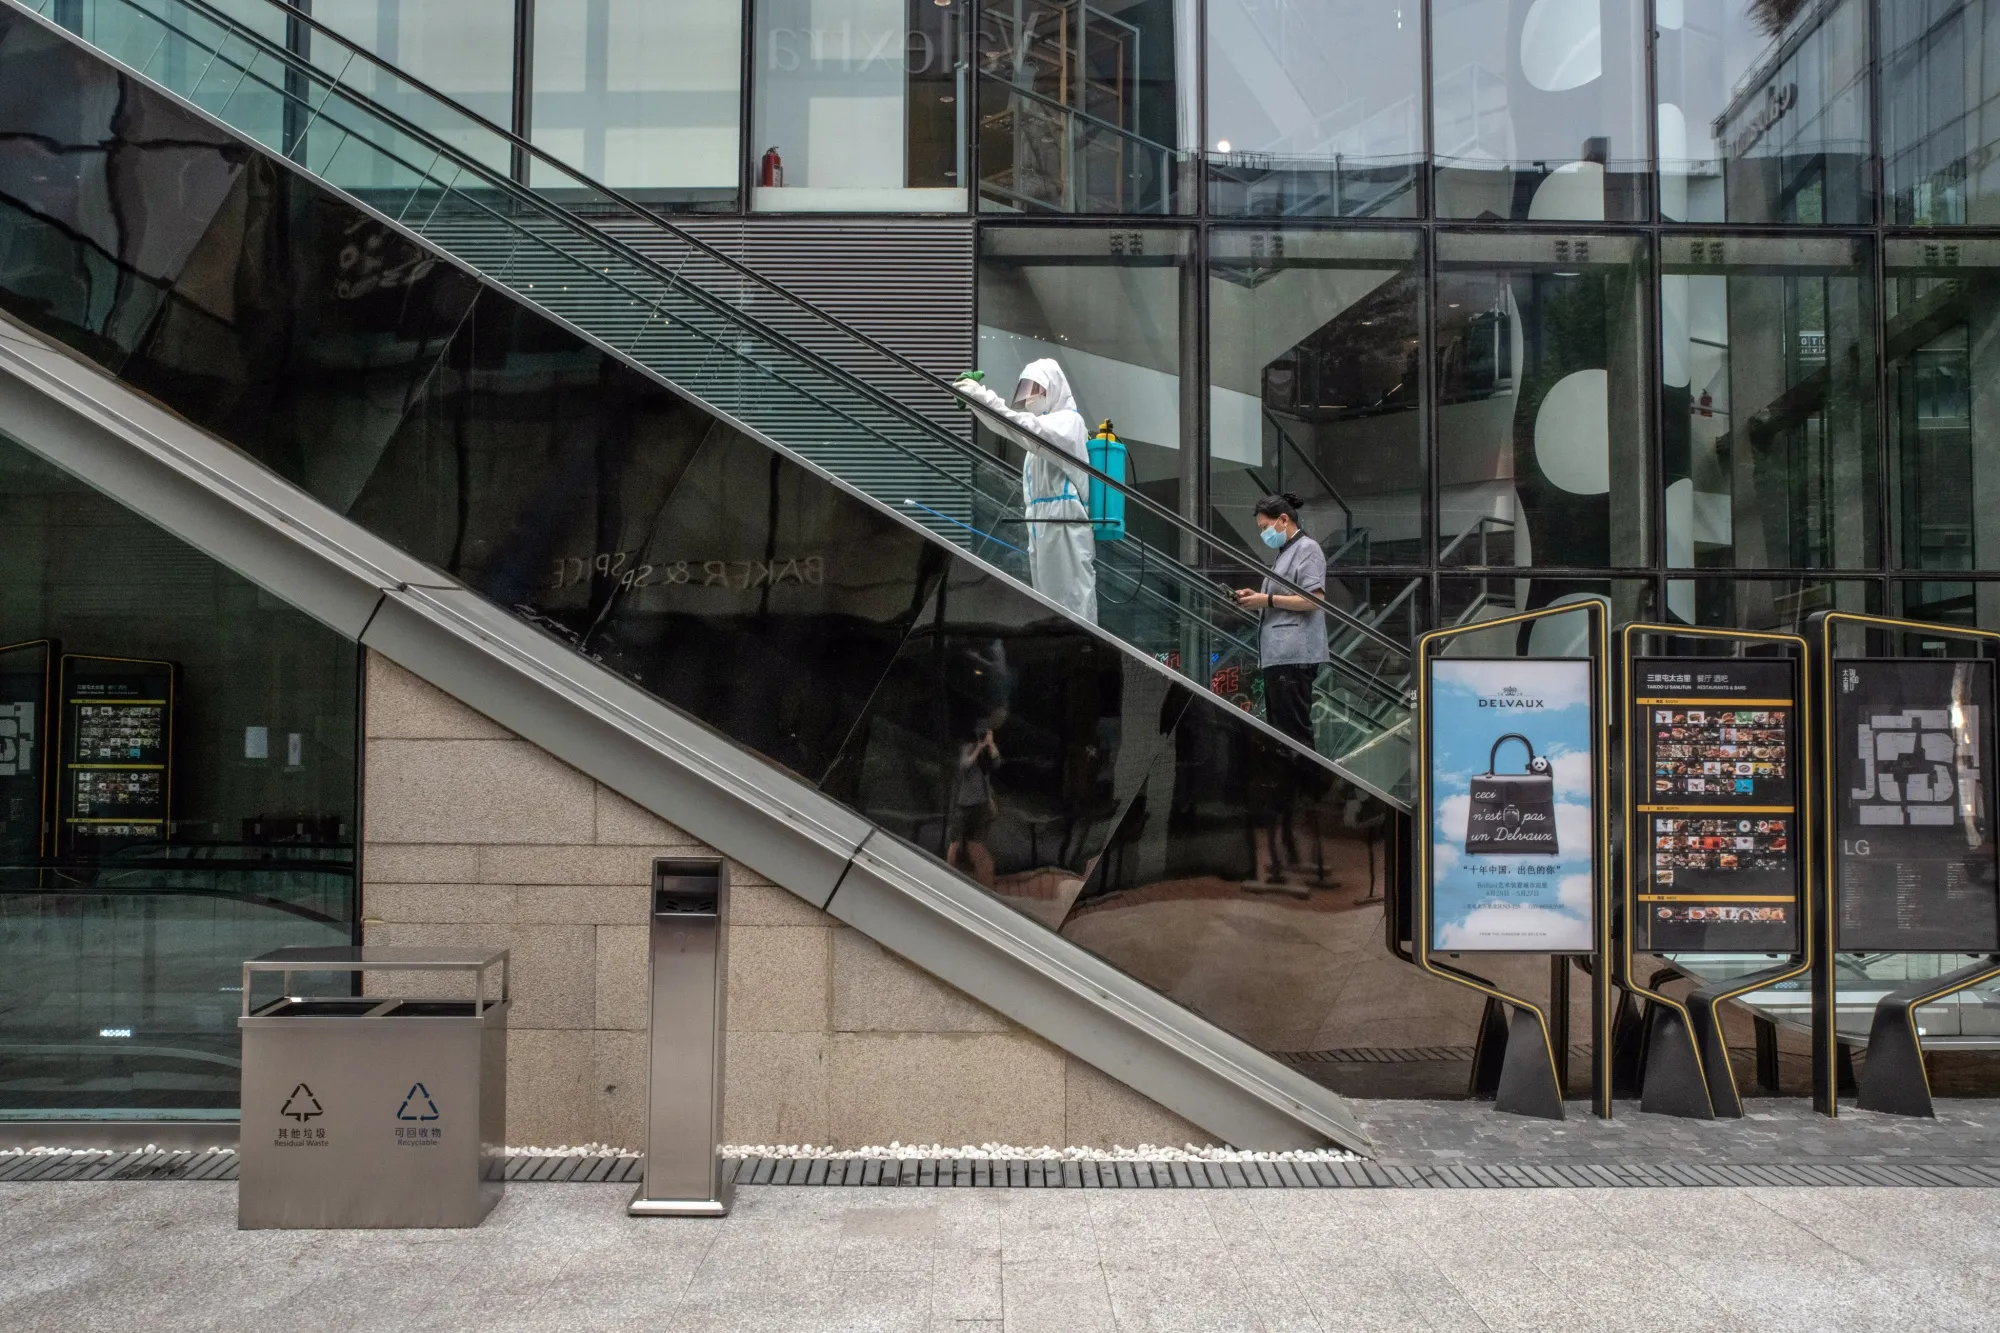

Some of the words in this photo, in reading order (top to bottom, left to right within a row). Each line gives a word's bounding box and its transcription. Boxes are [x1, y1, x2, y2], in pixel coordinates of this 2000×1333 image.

[1478, 699, 1545, 708] DELVAUX
[1475, 789, 1496, 799] ceci
[1473, 809, 1502, 821] n'est
[1521, 812, 1546, 825] pas
[1471, 833, 1490, 841] un
[1494, 827, 1552, 841] Delvaux
[1844, 839, 1870, 856] LG
[278, 1128, 326, 1139] 其他垃圾
[395, 1127, 442, 1138] 可回收物
[274, 1139, 305, 1147] Residual
[306, 1139, 329, 1147] Waste
[397, 1138, 438, 1147] Recyclable
